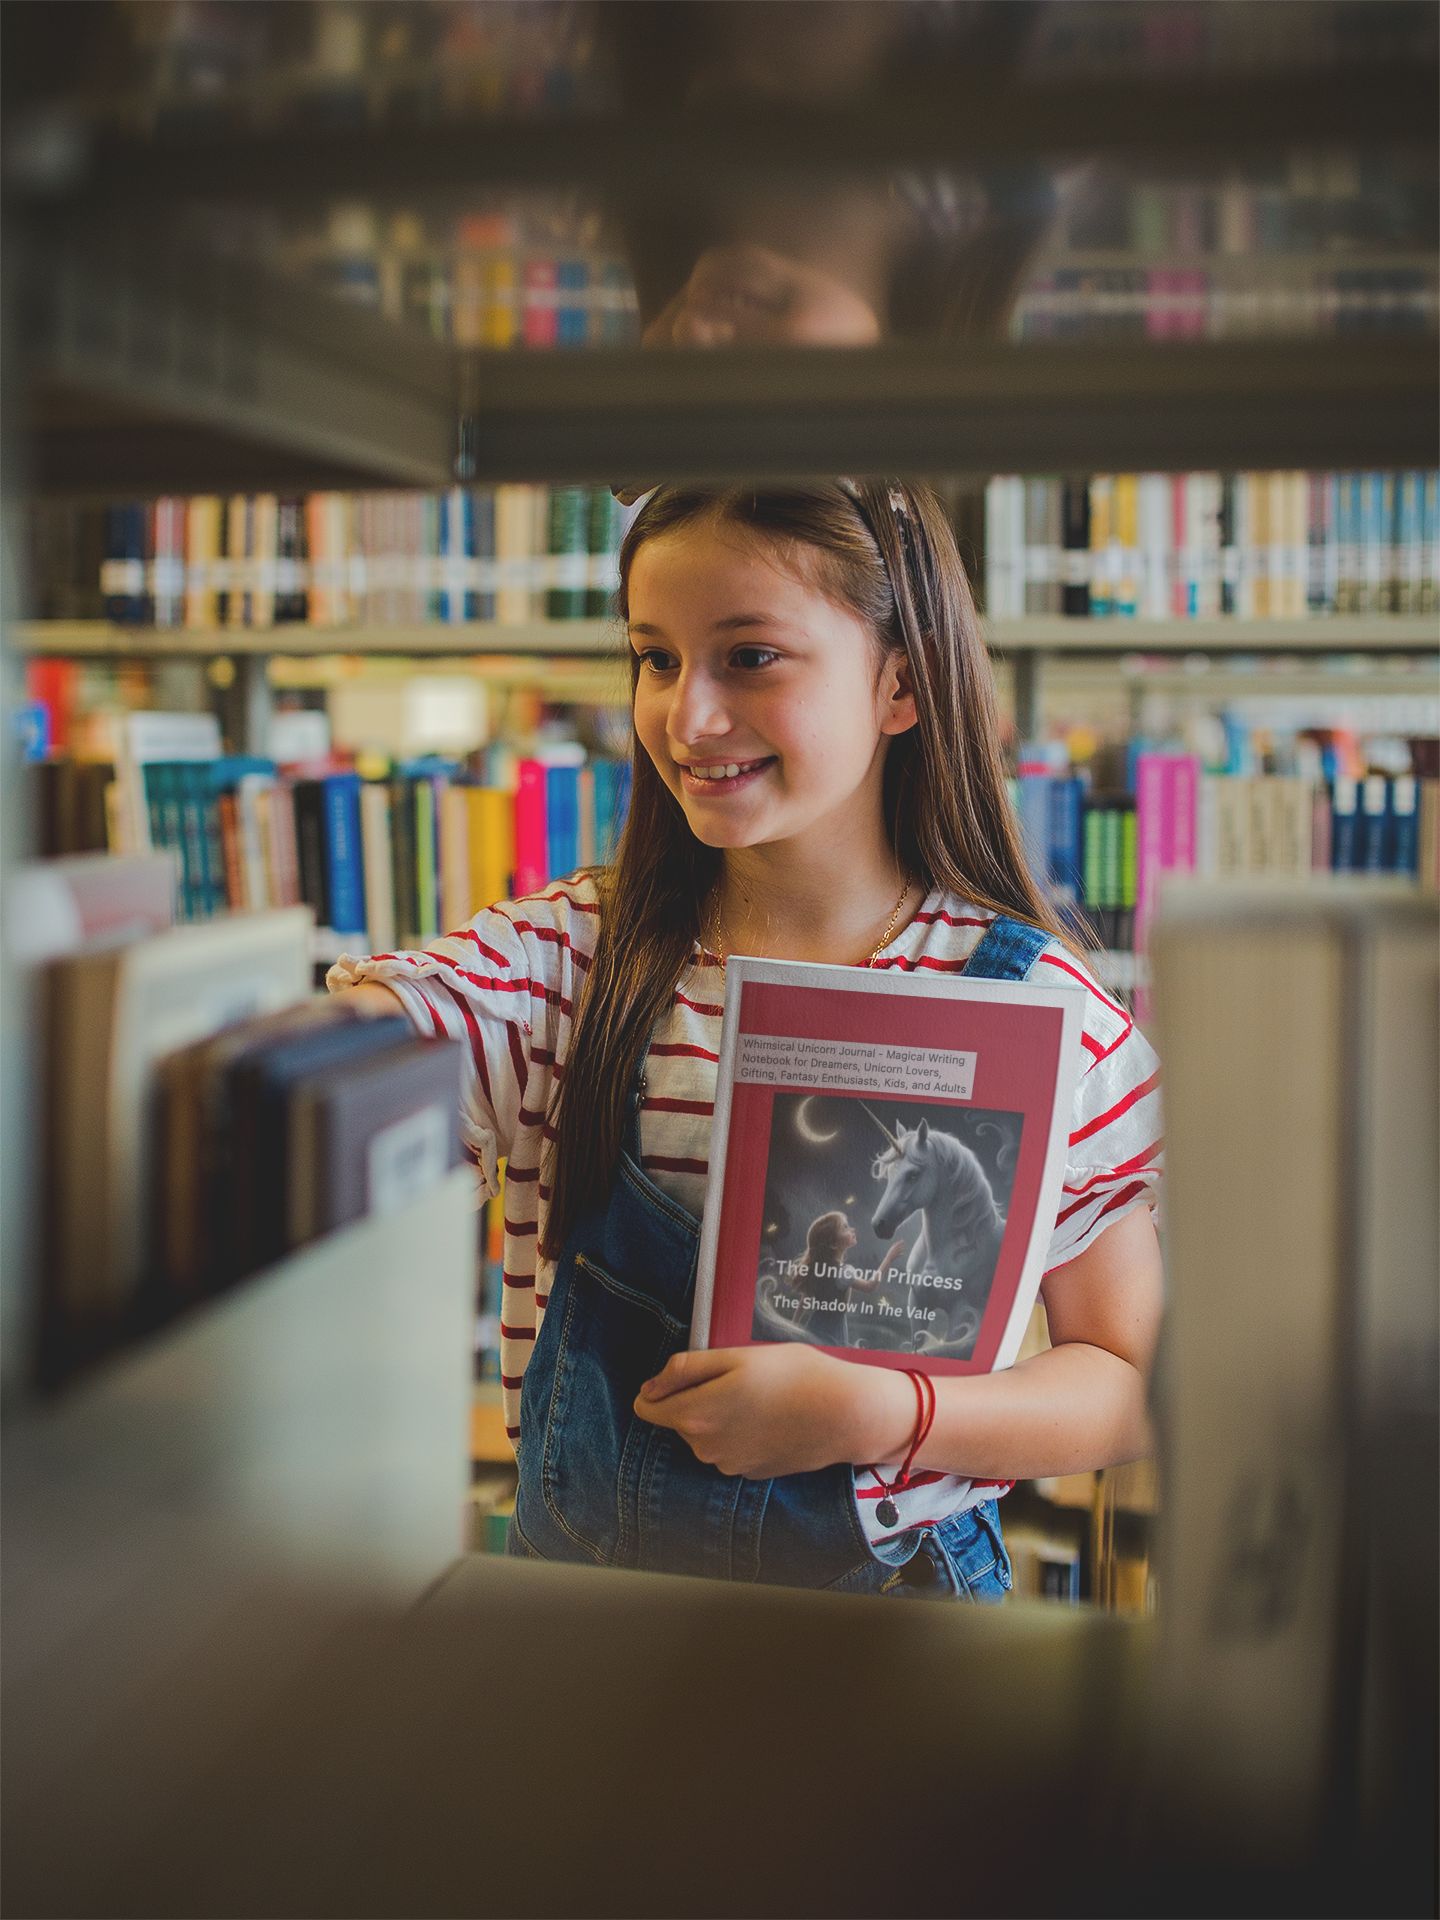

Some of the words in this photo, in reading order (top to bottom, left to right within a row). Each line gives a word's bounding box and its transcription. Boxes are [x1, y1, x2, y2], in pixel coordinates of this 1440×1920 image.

[744, 1039, 795, 1051] Whimsical
[797, 1044, 836, 1055] Unicorn
[839, 1046, 875, 1058] Journal
[886, 1050, 925, 1062] Magical
[929, 1053, 965, 1066] Writing
[742, 1054, 791, 1065] Notebook
[794, 1058, 808, 1067] for
[811, 1059, 860, 1072] Dreamers,
[864, 1063, 902, 1073] Unicorn
[906, 1066, 942, 1079] Lovers,
[741, 1068, 777, 1080] Gifting,
[780, 1071, 818, 1083] Fantasy
[822, 1074, 880, 1088] Enthusiasts,
[884, 1079, 908, 1090] Kids,
[912, 1080, 930, 1090] and
[934, 1083, 966, 1094] Adults
[777, 1260, 808, 1276] The
[814, 1262, 882, 1282] Unicorn
[887, 1268, 962, 1290] Princess
[773, 1296, 800, 1308] The
[802, 1298, 857, 1312] Shadow
[861, 1302, 873, 1314] In
[878, 1303, 902, 1317] The
[907, 1307, 936, 1320] Vale
